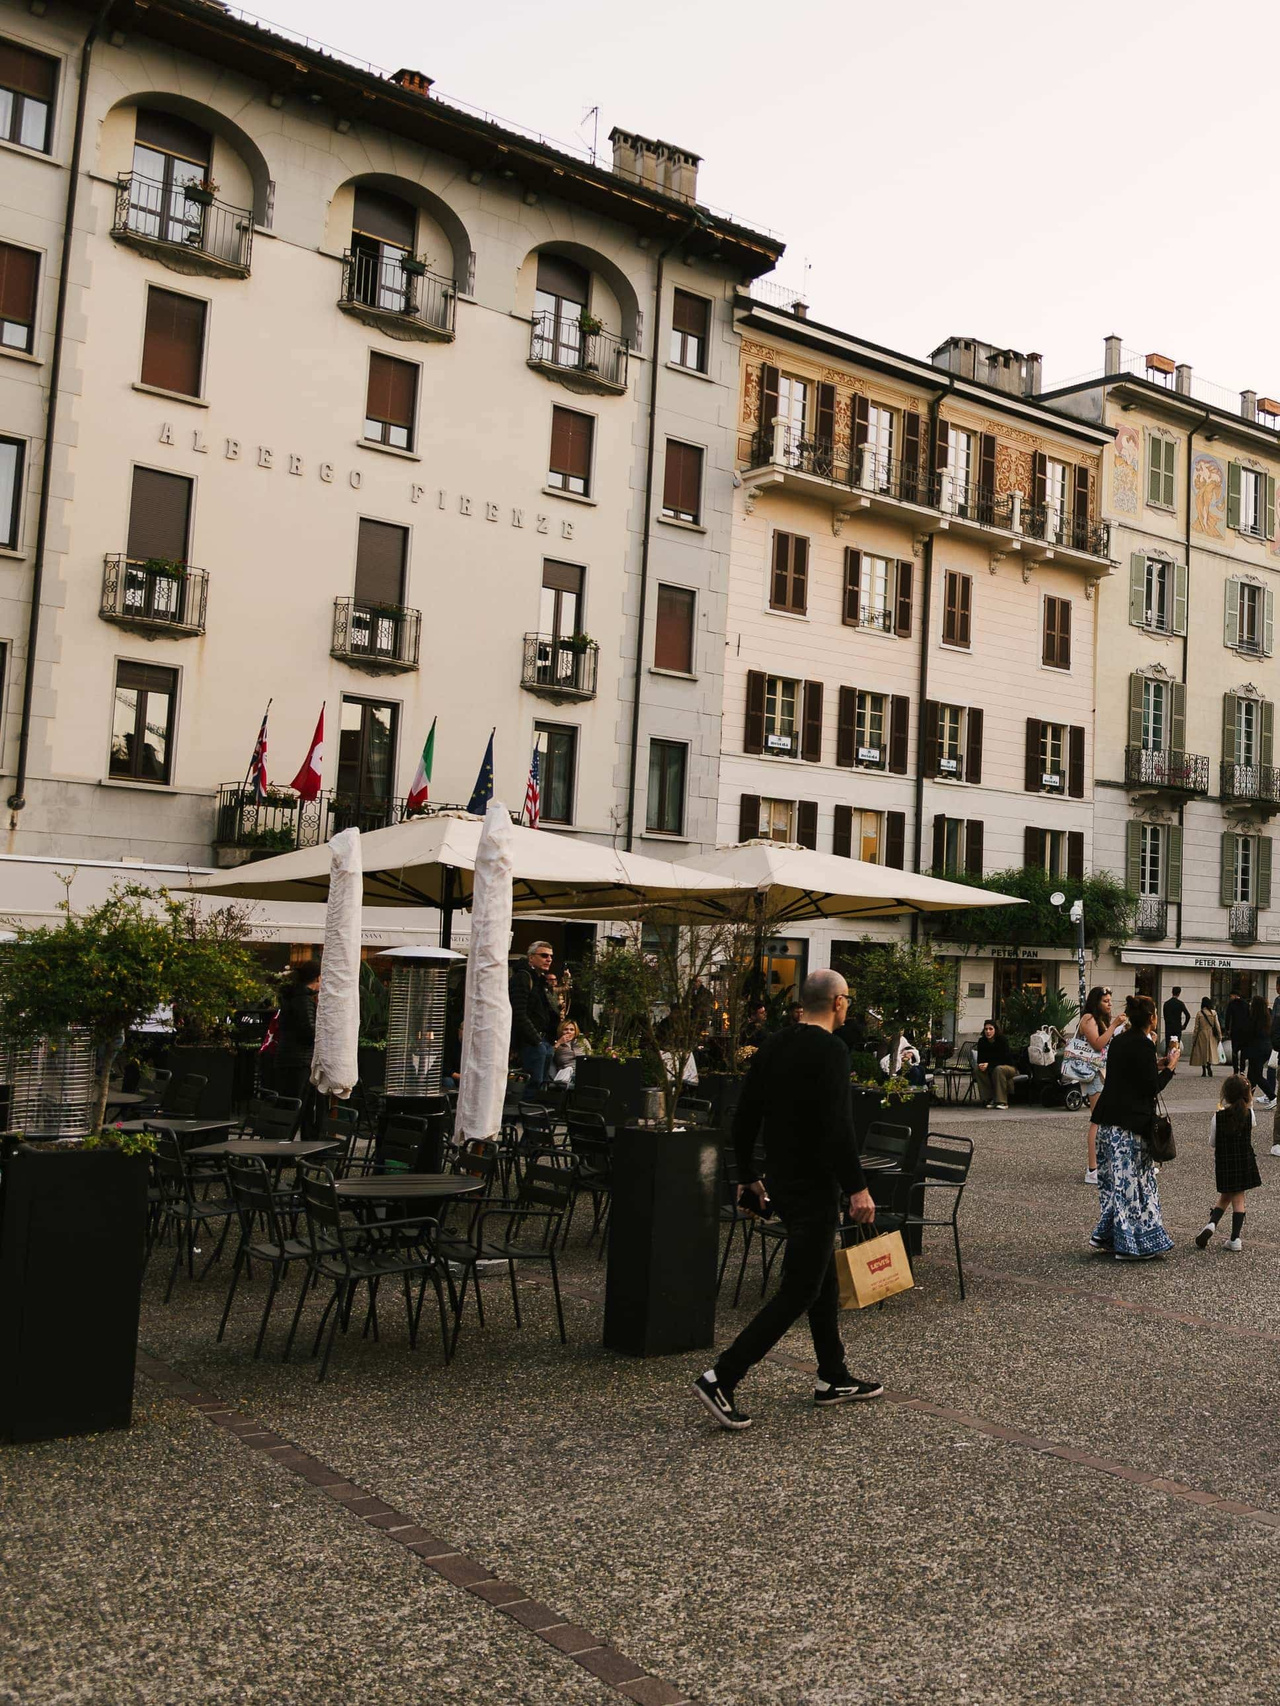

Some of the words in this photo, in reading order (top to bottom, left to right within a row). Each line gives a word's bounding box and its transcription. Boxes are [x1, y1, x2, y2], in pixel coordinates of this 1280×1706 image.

[160, 422, 364, 489] ALBERGO
[411, 483, 575, 540] FIRENZE
[991, 948, 1018, 958] PETER
[1022, 950, 1038, 958] PAN
[1195, 959, 1216, 967] PETER
